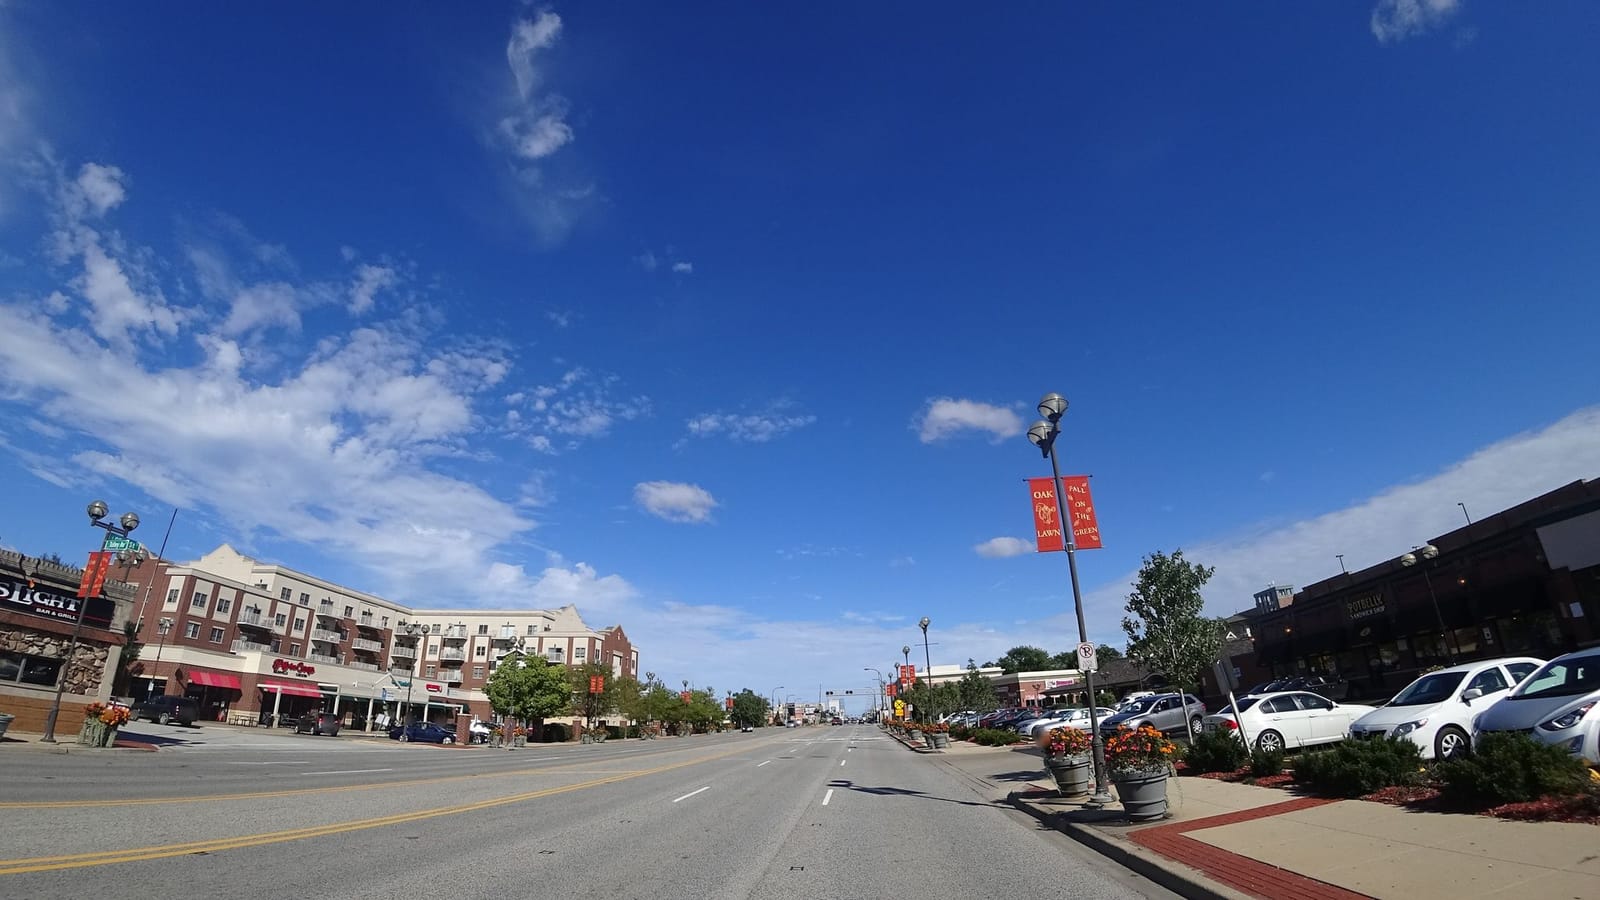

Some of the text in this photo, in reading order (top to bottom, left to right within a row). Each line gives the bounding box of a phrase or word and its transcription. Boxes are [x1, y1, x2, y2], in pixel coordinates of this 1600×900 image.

[1069, 485, 1087, 494] FALL
[1033, 490, 1054, 499] OAK
[1074, 500, 1086, 508] ON
[1075, 512, 1091, 521] THE
[1037, 528, 1061, 538] LAWN
[1073, 527, 1098, 537] GREEN
[1347, 594, 1383, 614] POTBELLY
[36, 607, 50, 615] BAR
[57, 612, 77, 621] GRILL
